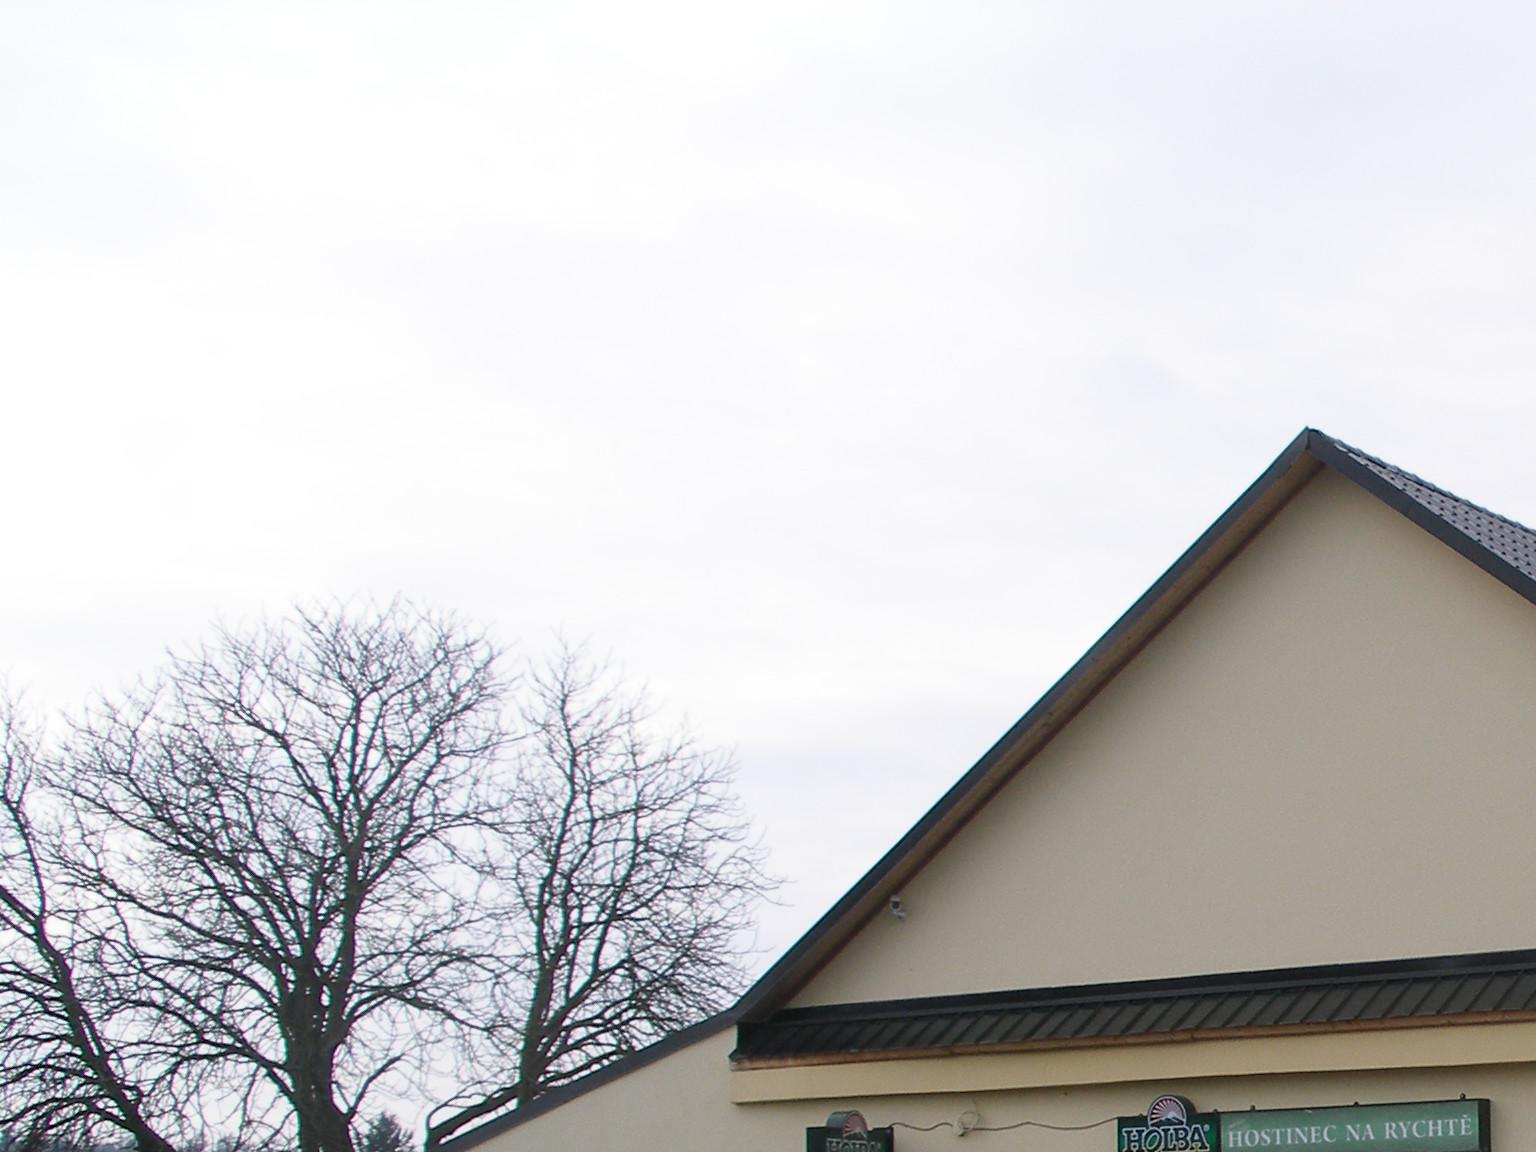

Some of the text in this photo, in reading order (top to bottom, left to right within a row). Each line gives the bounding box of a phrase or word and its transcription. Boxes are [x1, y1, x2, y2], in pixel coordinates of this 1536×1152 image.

[1228, 1114, 1473, 1148] HOSTINEC NA RYCHTĚ
